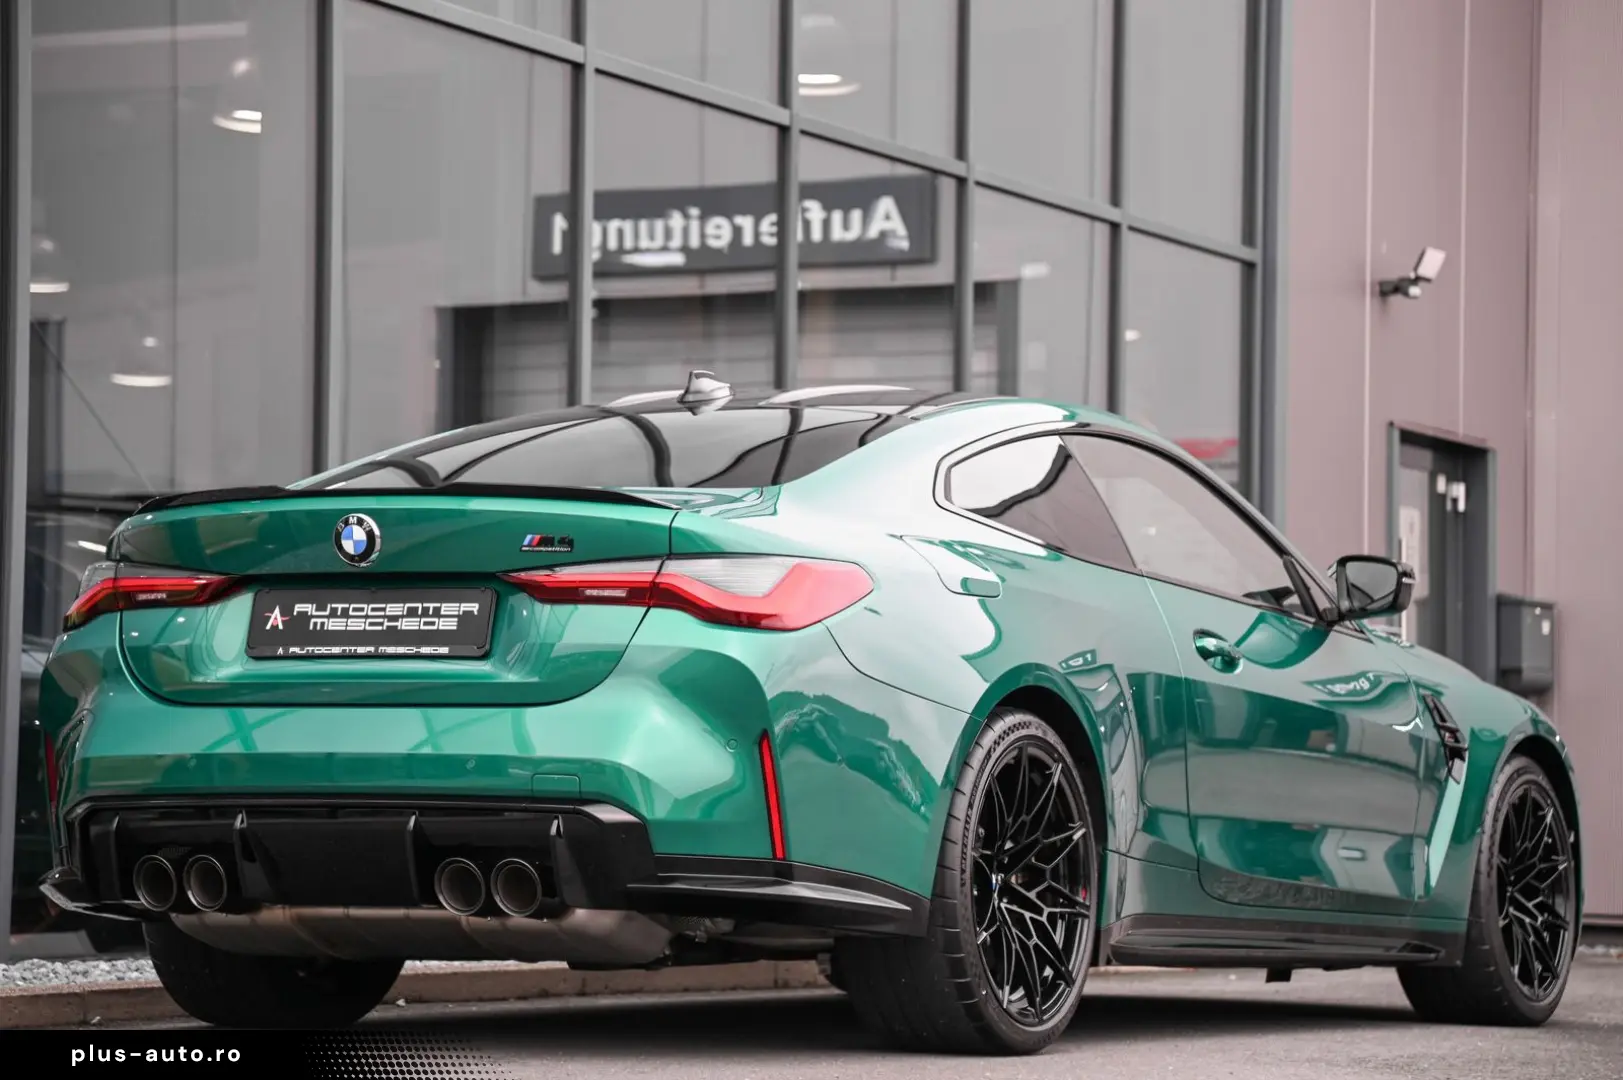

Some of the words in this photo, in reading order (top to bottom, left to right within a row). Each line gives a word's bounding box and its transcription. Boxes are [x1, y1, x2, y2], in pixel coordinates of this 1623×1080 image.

[337, 516, 372, 532] BMW
[293, 603, 479, 616] AUTOCENTER
[309, 617, 459, 631] MESCHEDE
[288, 646, 375, 654] AUTOCENTER
[377, 646, 450, 654] MESCHEDE
